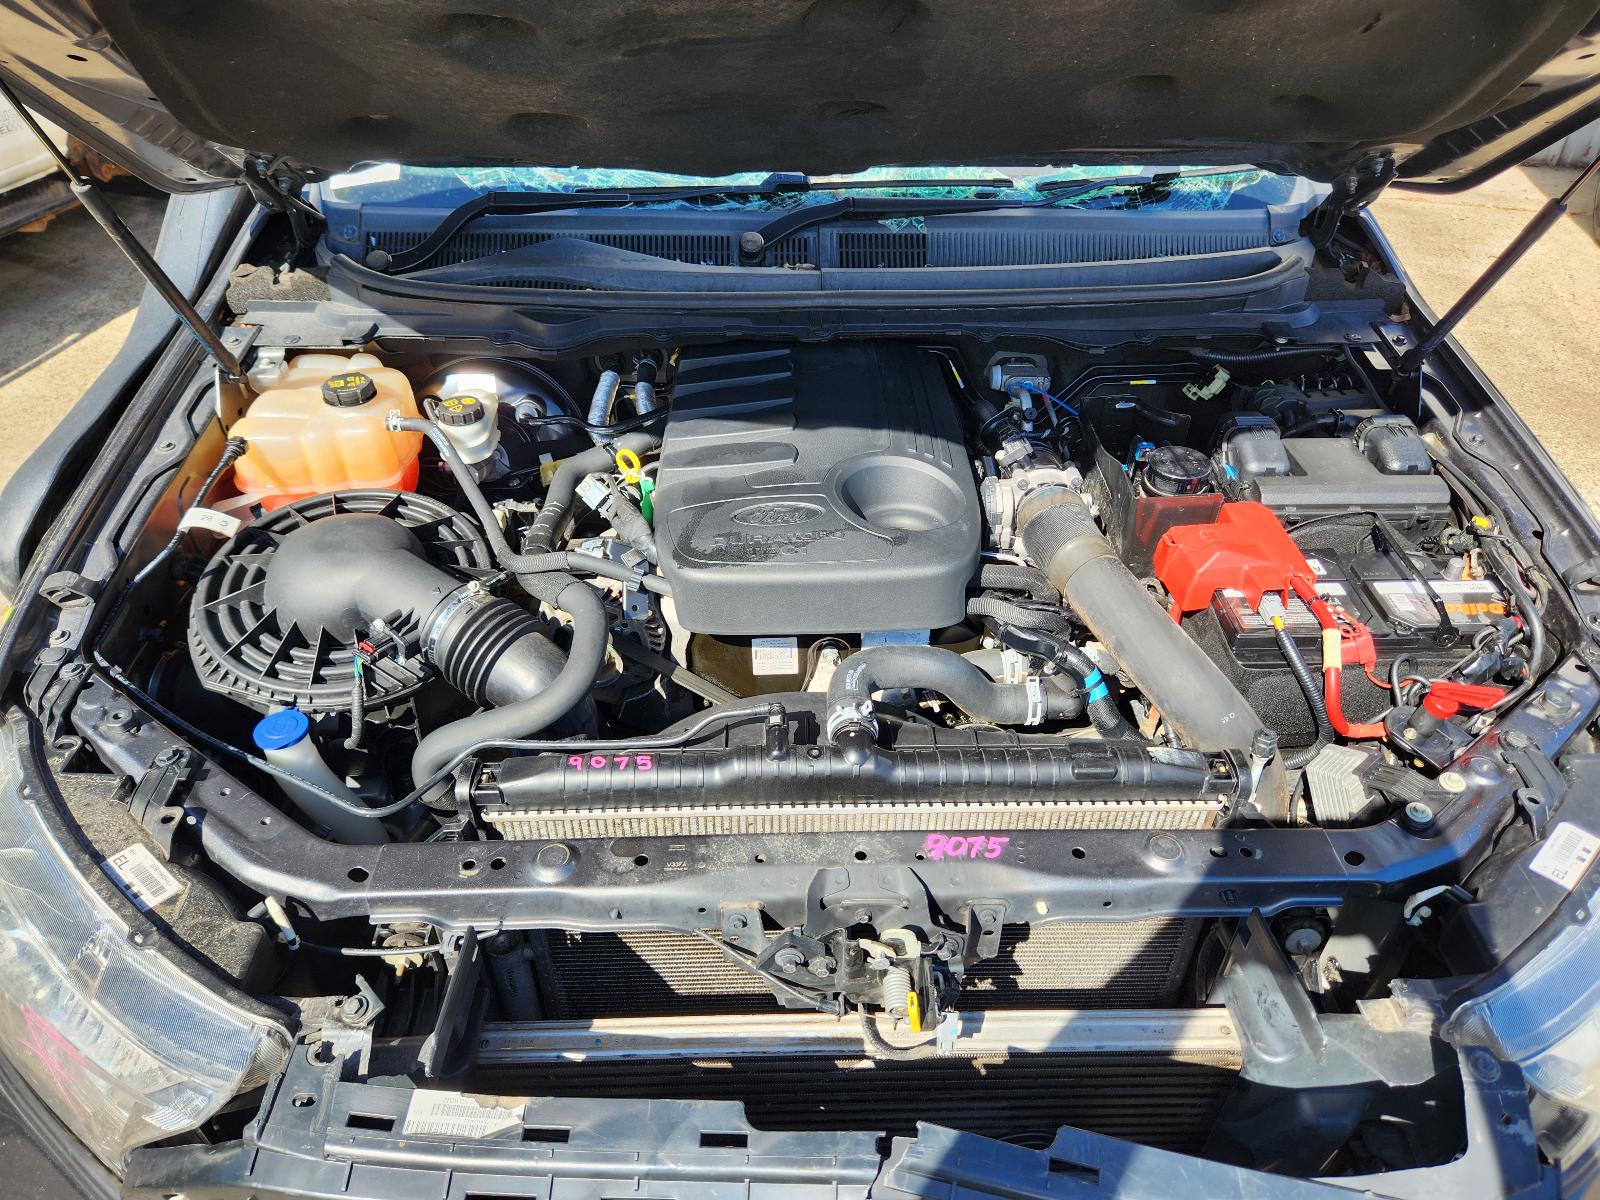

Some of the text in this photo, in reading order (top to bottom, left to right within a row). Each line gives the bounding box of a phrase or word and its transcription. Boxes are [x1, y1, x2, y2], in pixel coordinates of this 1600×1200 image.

[750, 506, 809, 524] Ford
[1444, 603, 1504, 616] Delko
[568, 755, 653, 771] 9075
[925, 833, 1010, 860] 9075
[112, 855, 129, 871] EL
